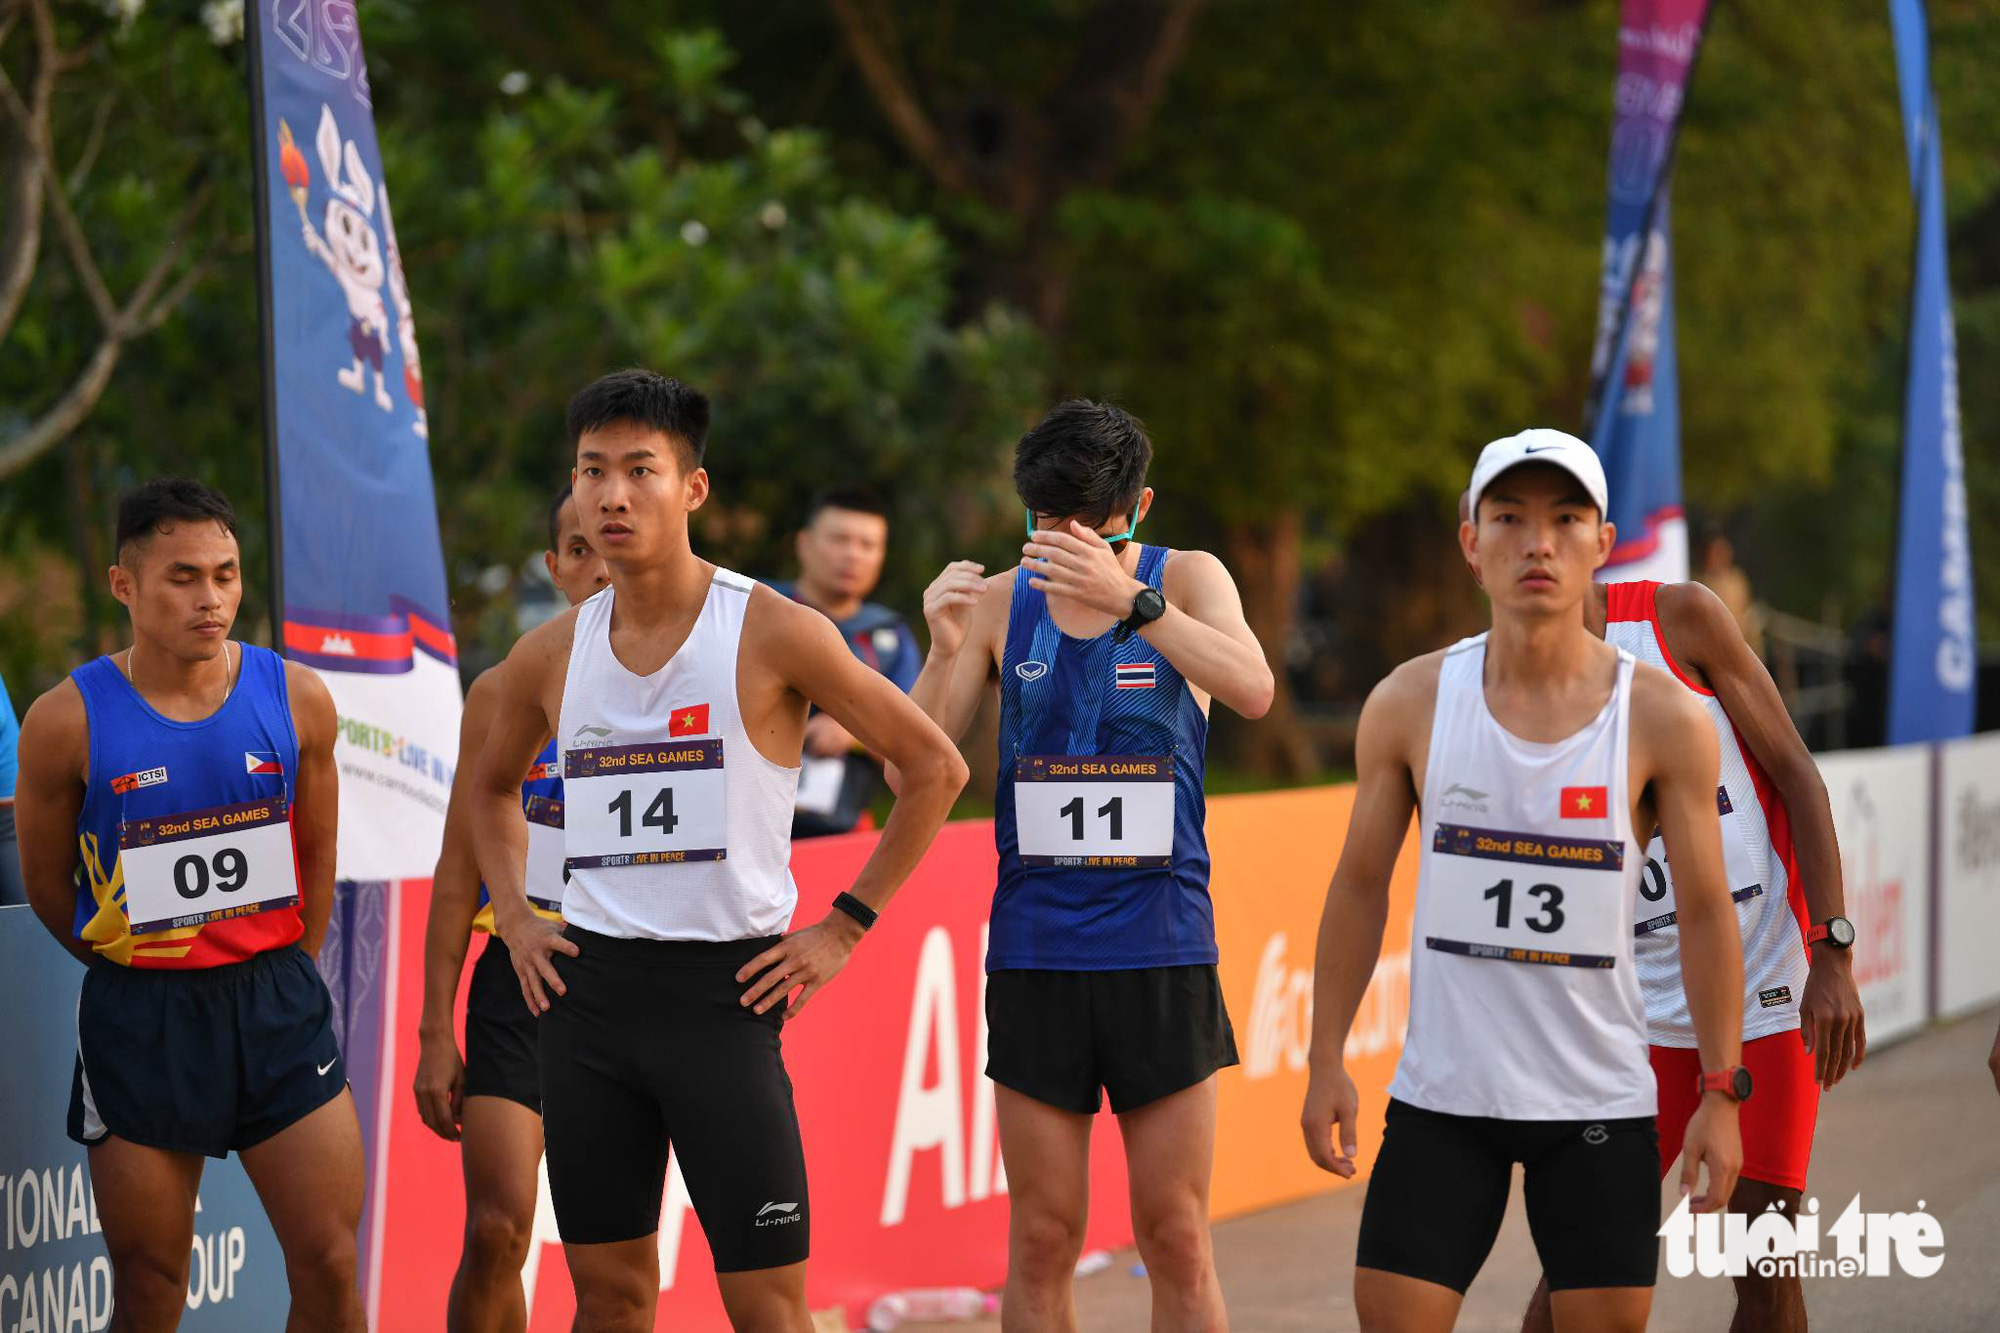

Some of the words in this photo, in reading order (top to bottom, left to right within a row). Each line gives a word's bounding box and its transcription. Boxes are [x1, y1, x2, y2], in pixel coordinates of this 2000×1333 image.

[573, 739, 614, 748] LI-NING
[599, 755, 626, 768] 32nd
[629, 752, 655, 766] SEA
[657, 750, 704, 764] GAMES
[1049, 763, 1078, 775] 32nd
[1081, 763, 1107, 775] SEA
[1111, 763, 1157, 775] GAMES
[138, 769, 165, 782] ICTSI
[158, 821, 190, 837] 32nd
[193, 816, 220, 831] SEA
[222, 807, 270, 826] GAMES
[608, 787, 679, 838] 14
[1060, 796, 1123, 841] 11
[601, 855, 630, 867] SPORTS
[632, 854, 649, 864] LIVE
[650, 853, 659, 863] IN
[660, 851, 686, 863] PEACE
[1054, 856, 1082, 867] SPORTS
[1084, 856, 1101, 867] LIVE
[1102, 856, 1111, 867] IN
[1113, 856, 1138, 867] PEACE
[1476, 837, 1511, 853] 32nd
[1514, 841, 1544, 857] SEA
[1547, 845, 1603, 862] GAMES
[173, 847, 248, 900] 09
[1639, 853, 1673, 902] 0
[172, 914, 204, 929] SPORTS
[207, 911, 224, 923] LIVE
[226, 908, 235, 919] IN
[236, 903, 261, 917] PEACE
[1483, 878, 1565, 934] 13
[1647, 914, 1672, 931] SPORTS
[879, 920, 1009, 1227] AI
[755, 1213, 801, 1227] LI-NING
[0, 1256, 115, 1333] CANAD
[186, 1226, 246, 1310] OUP
